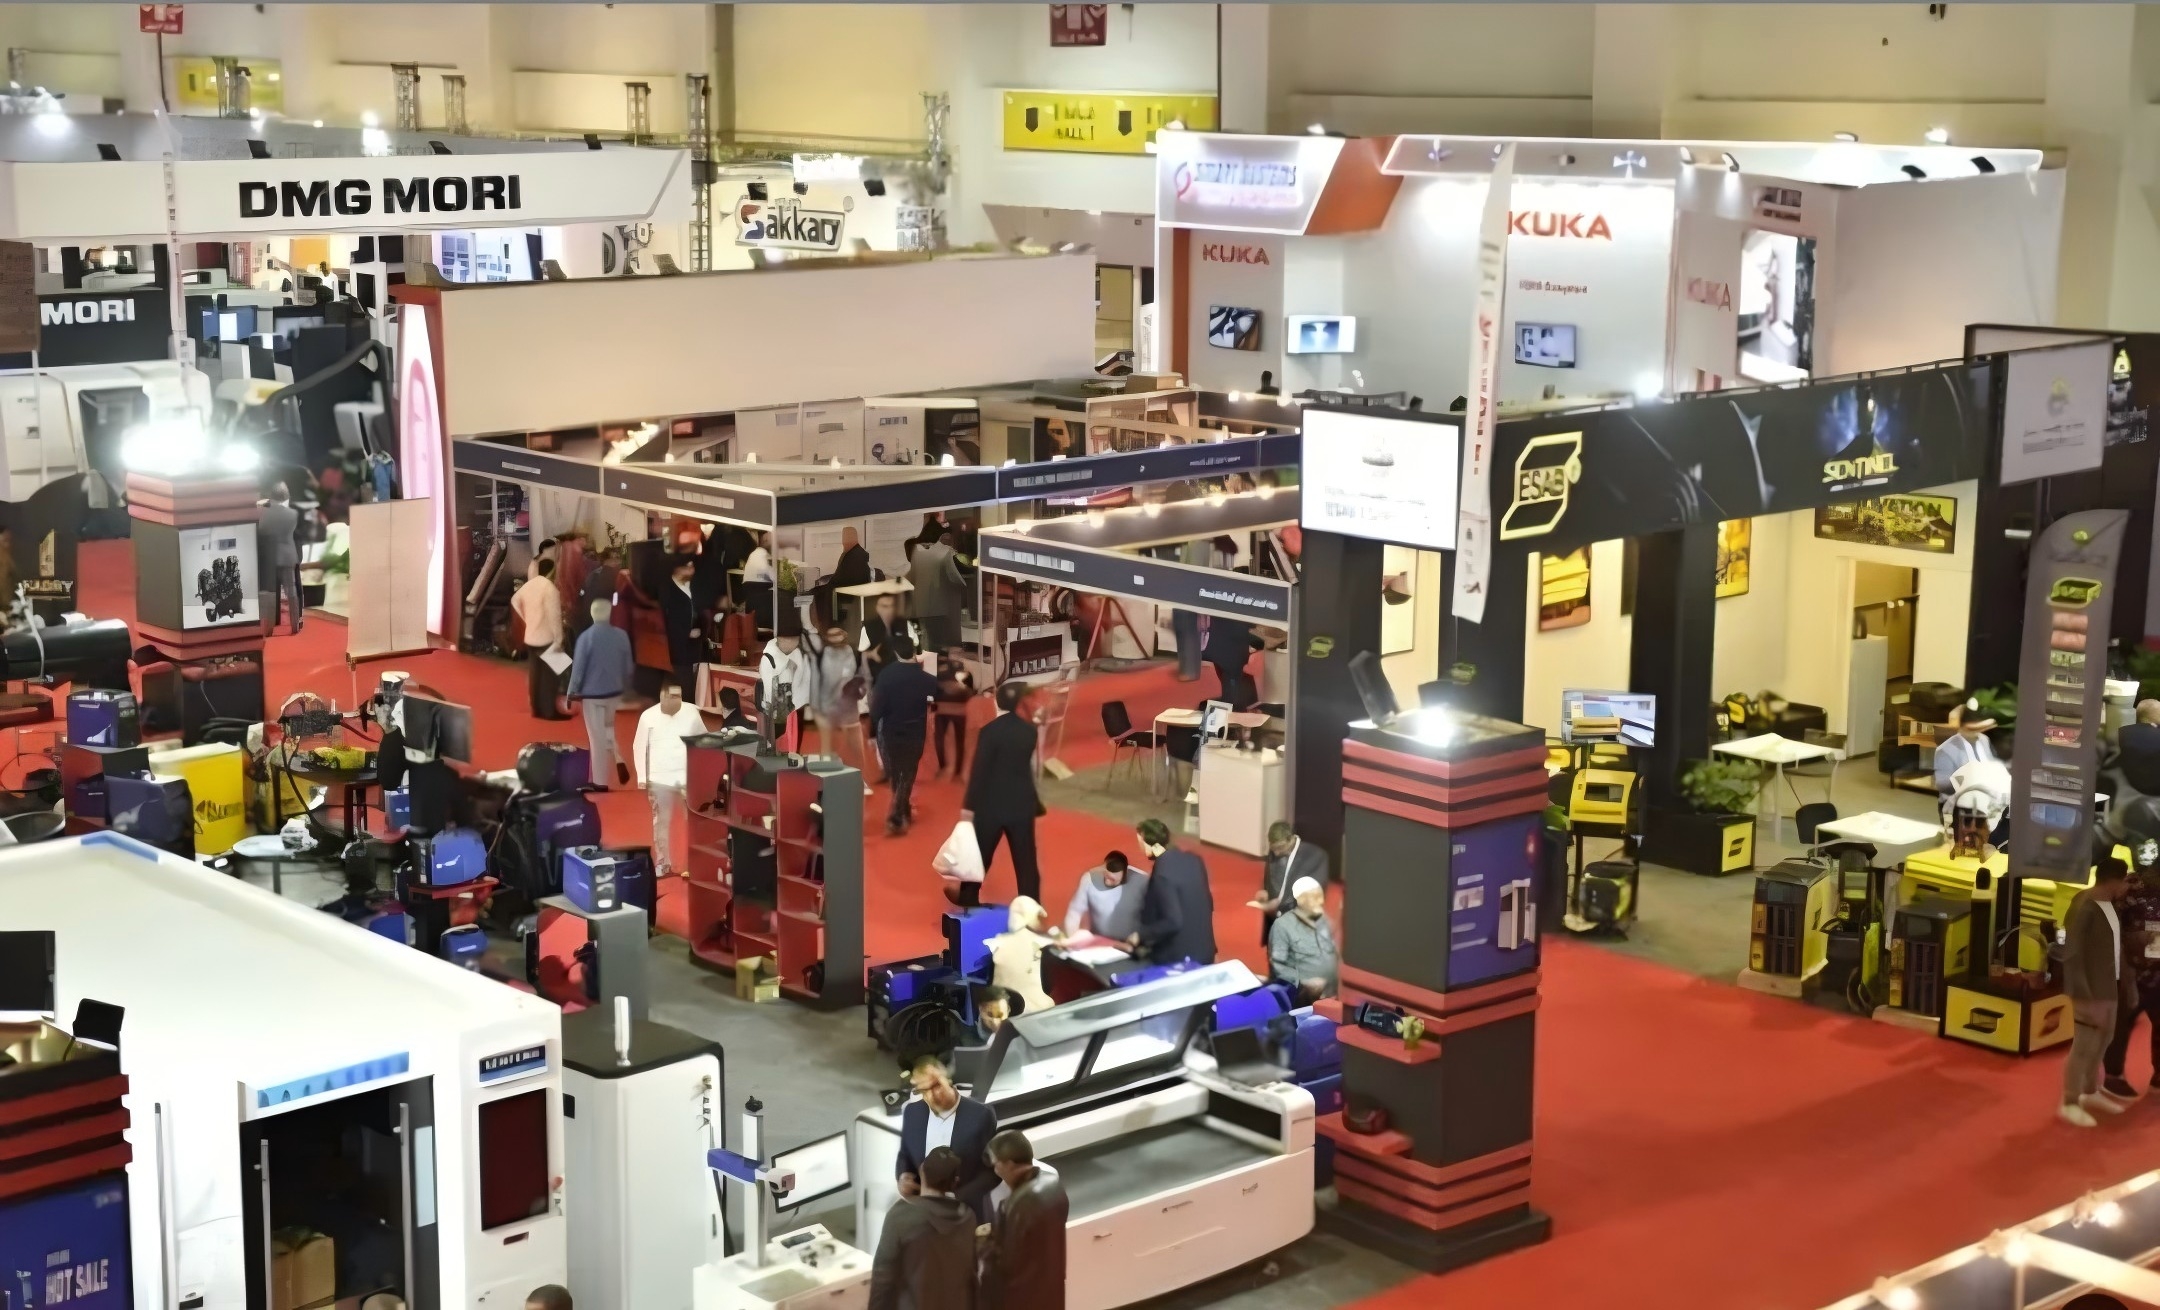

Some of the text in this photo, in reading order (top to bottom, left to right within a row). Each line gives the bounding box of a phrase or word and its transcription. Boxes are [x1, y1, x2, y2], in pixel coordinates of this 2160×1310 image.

[239, 174, 522, 219] DMG MORI
[1506, 210, 1613, 242] KUKA
[1202, 243, 1270, 266] KUKA
[39, 298, 136, 326] MORI
[75, 1258, 109, 1298] SALE
